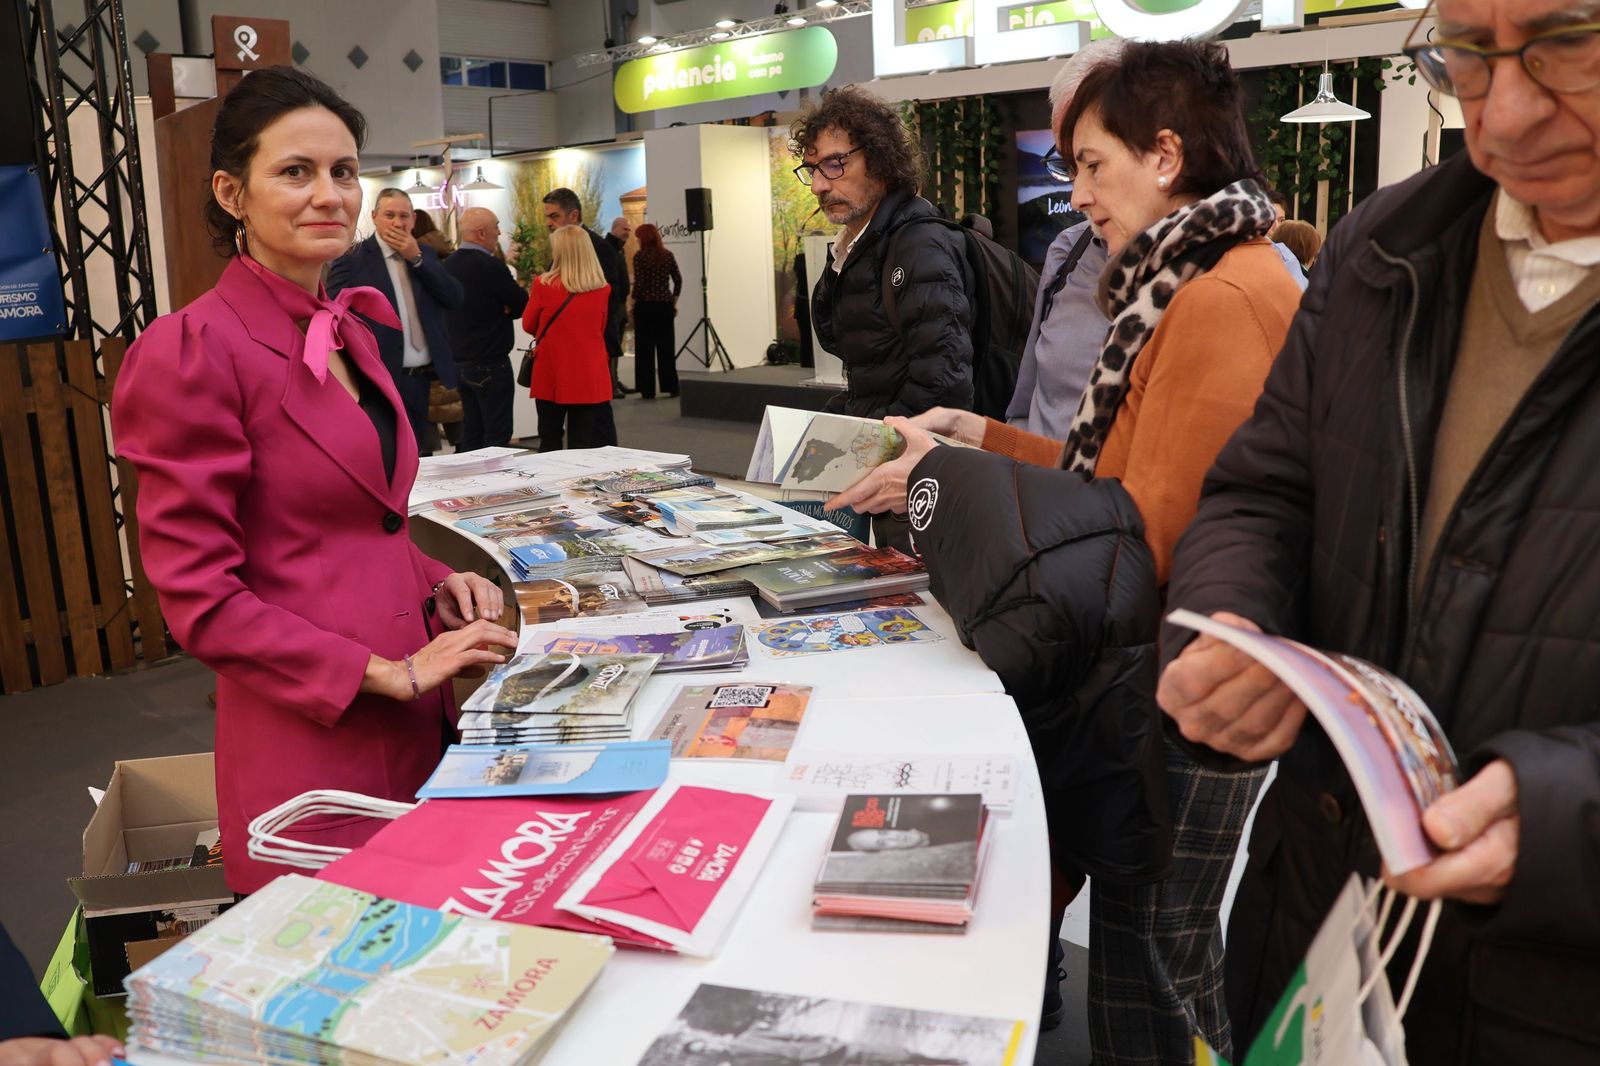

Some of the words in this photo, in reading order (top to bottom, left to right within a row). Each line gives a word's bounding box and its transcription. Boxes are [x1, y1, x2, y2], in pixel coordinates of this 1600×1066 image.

[643, 54, 737, 101] palencia
[769, 64, 783, 79] pe
[437, 811, 593, 911] ZAMORA
[473, 957, 560, 1031] ZAMORA
